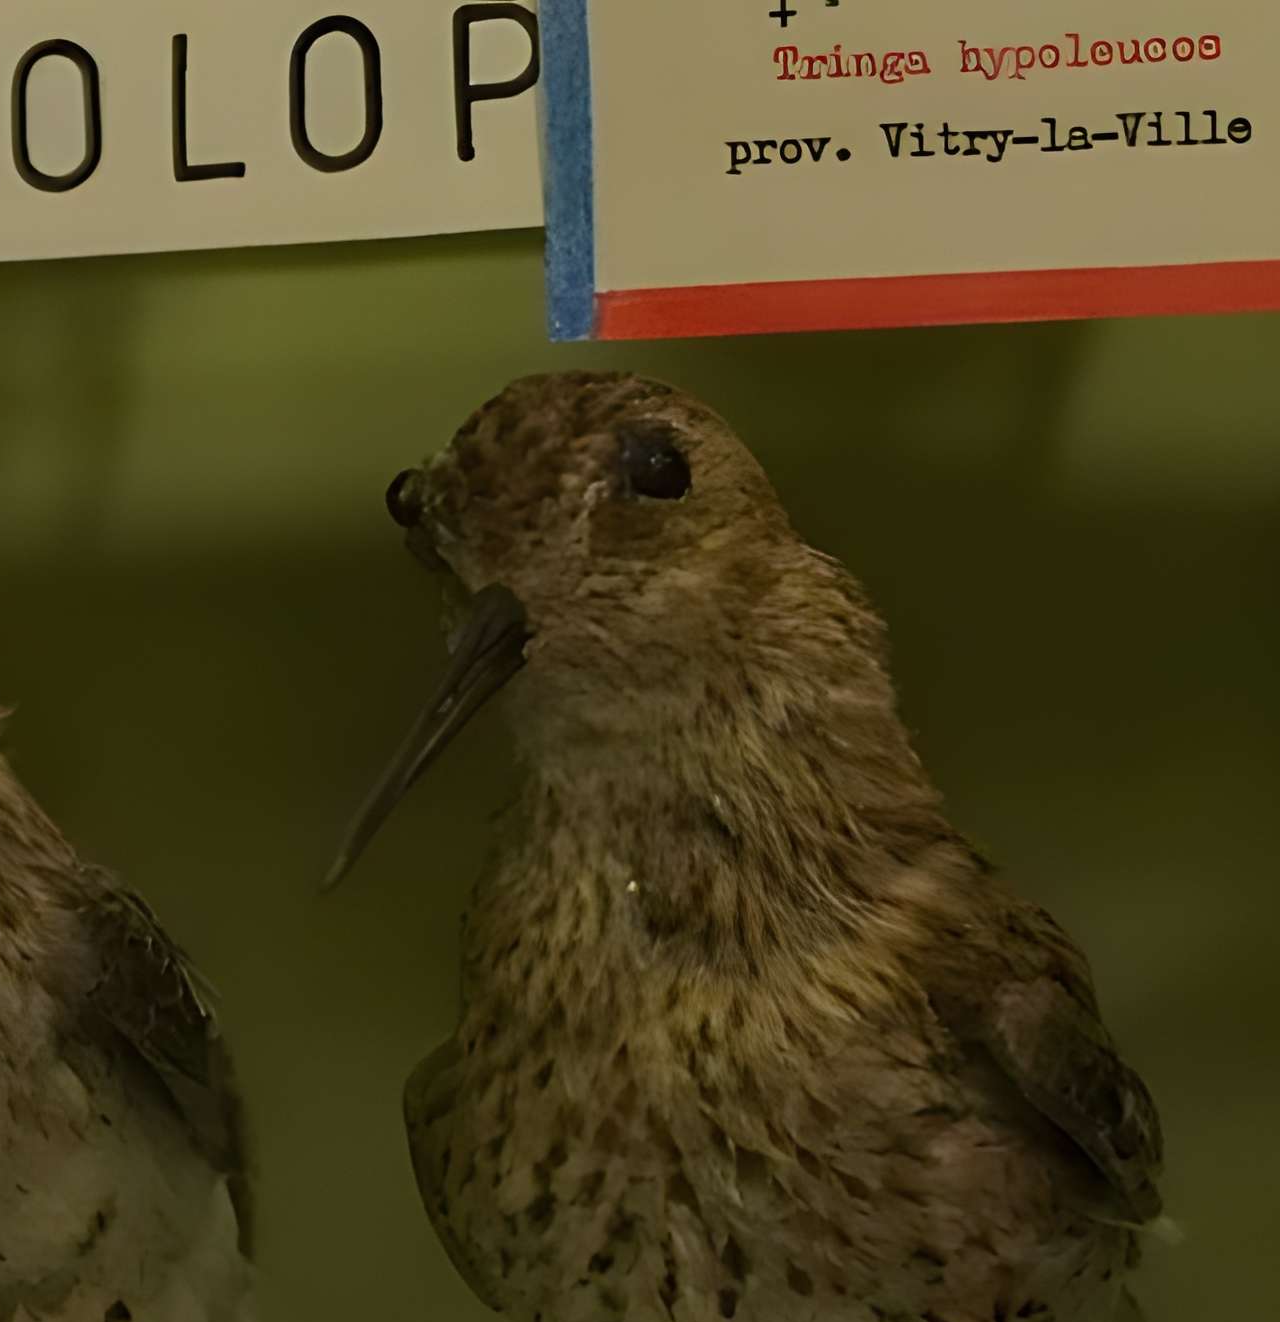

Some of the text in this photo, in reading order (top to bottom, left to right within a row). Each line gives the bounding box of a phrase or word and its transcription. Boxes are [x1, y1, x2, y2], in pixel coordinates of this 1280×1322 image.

[773, 44, 933, 84] Tringa
[724, 110, 1252, 175] prov. Vitry-la-Ville
